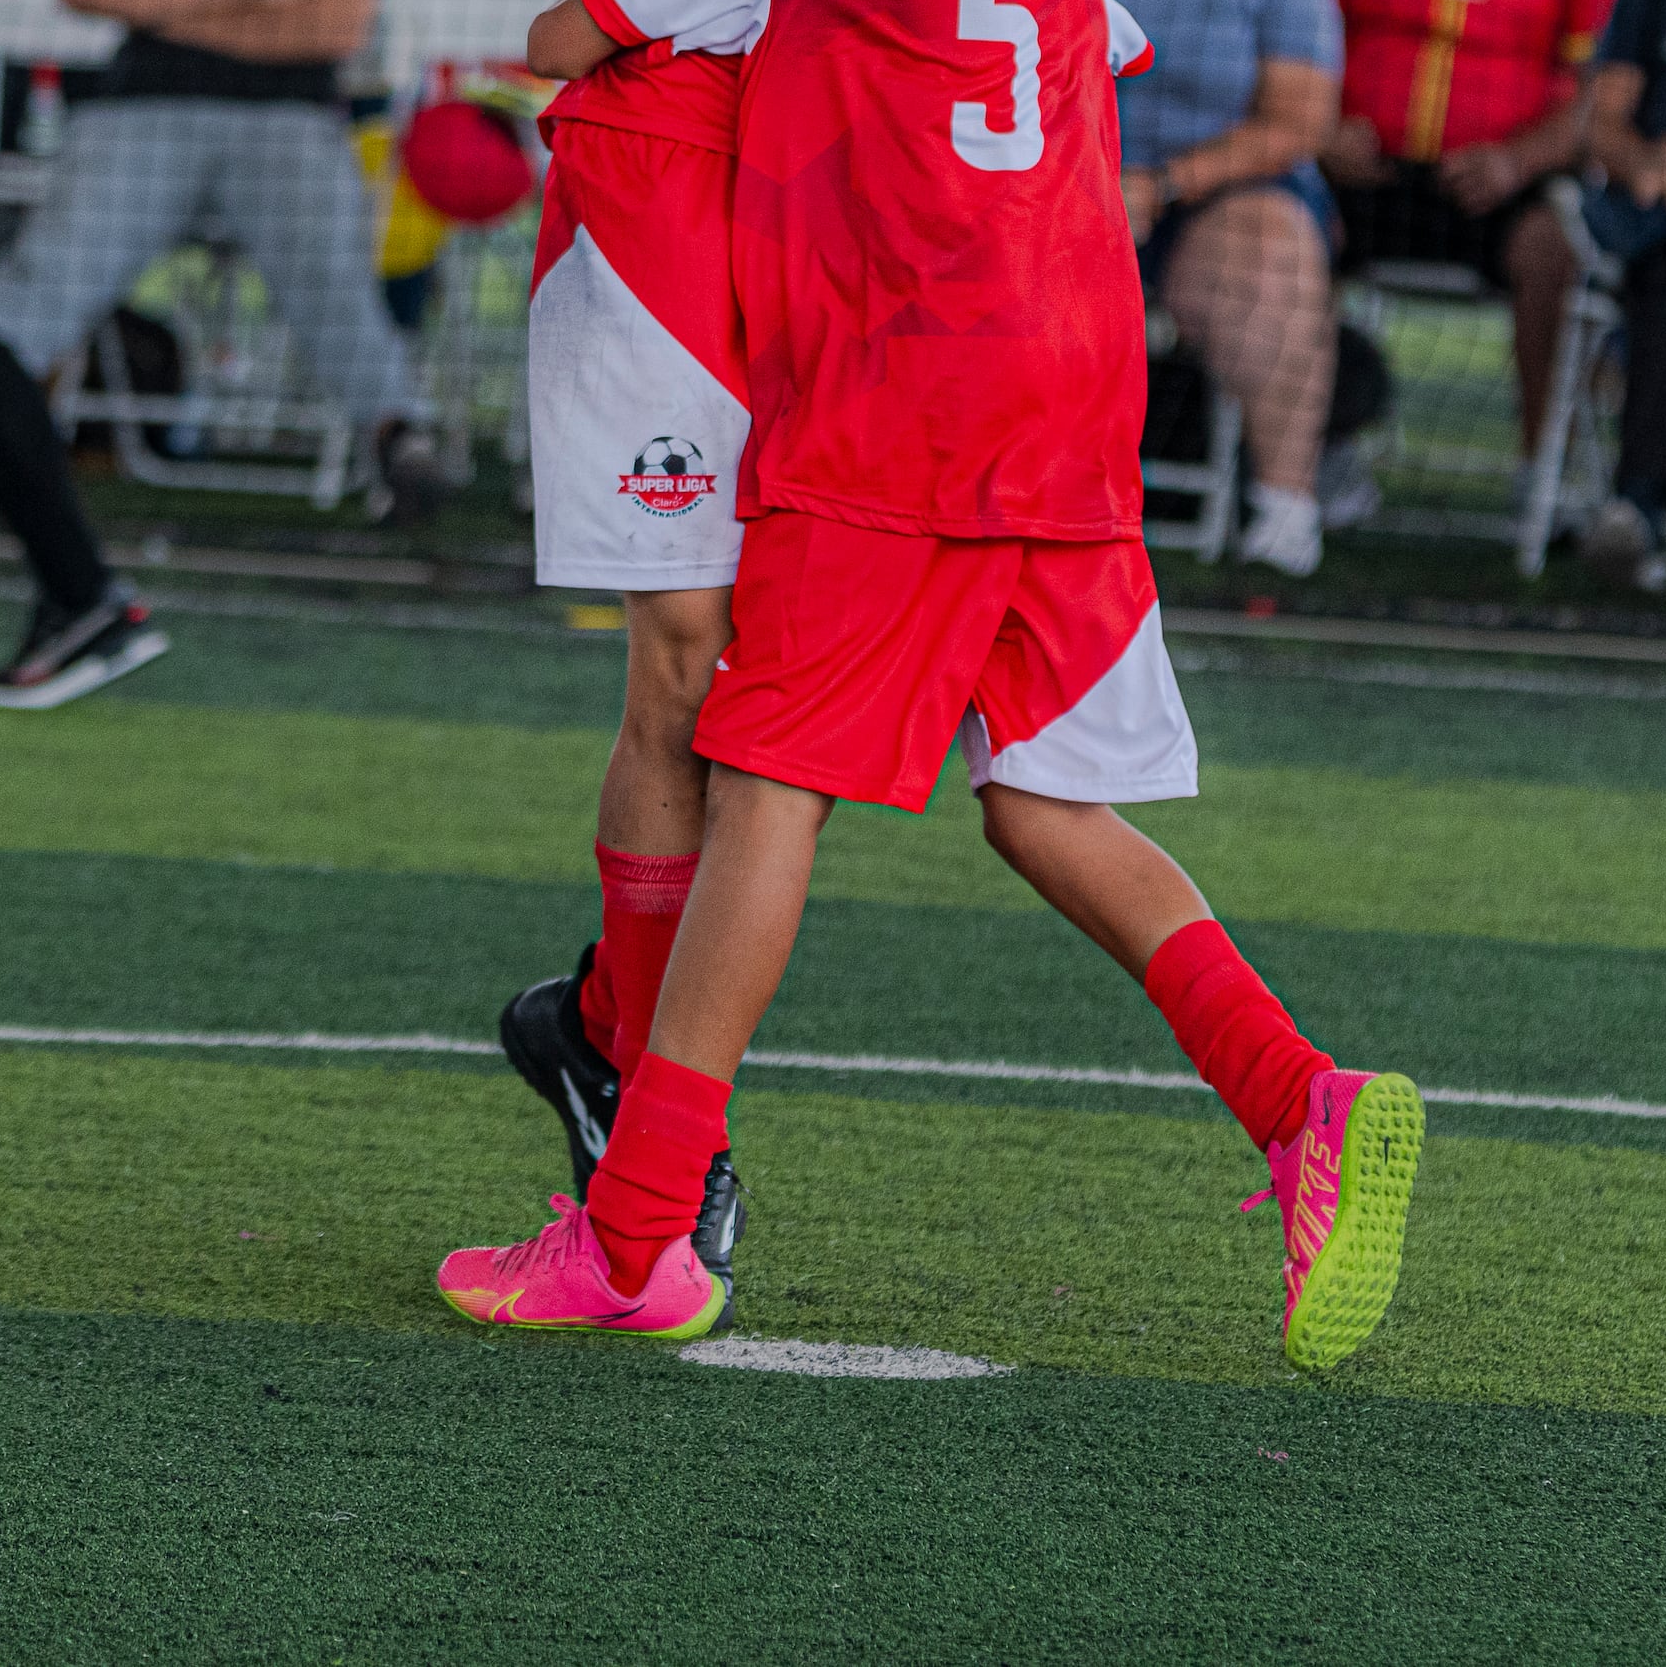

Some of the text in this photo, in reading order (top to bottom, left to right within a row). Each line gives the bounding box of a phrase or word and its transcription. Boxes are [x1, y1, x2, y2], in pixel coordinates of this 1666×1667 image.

[628, 477, 709, 493] SUPER LIGA
[631, 496, 704, 518] INTERNACIONAL
[652, 496, 681, 508] Claro
